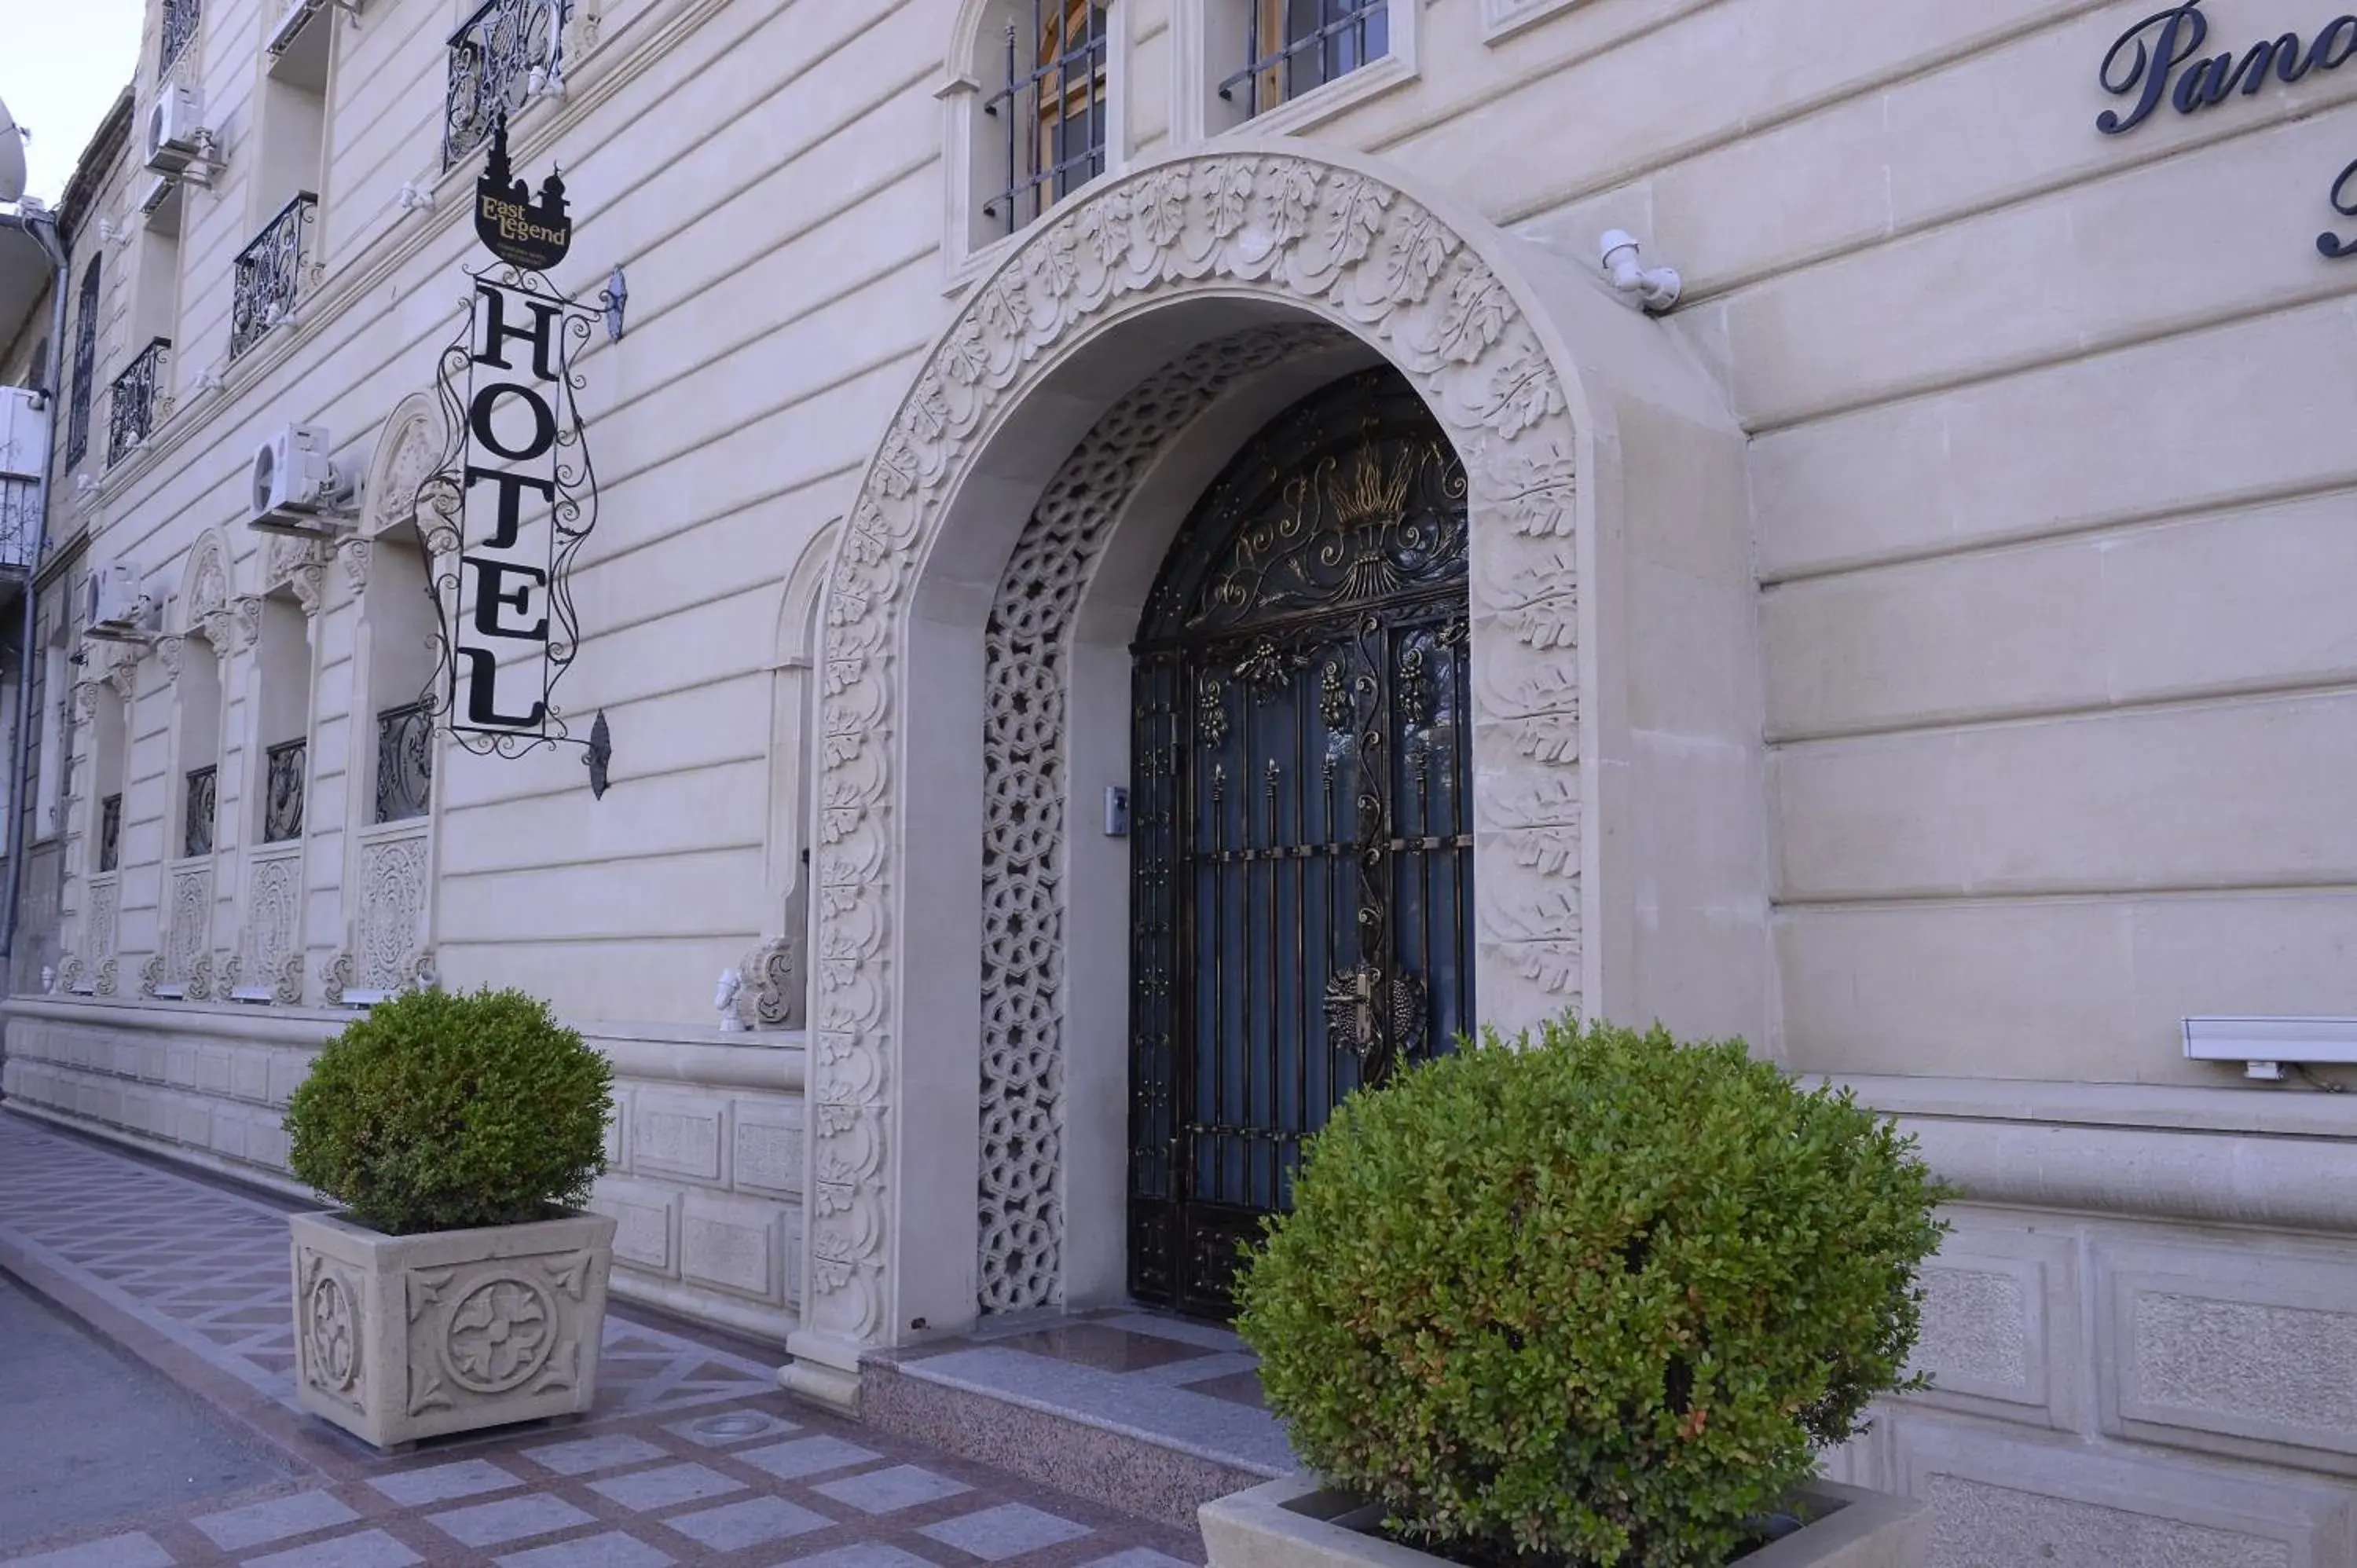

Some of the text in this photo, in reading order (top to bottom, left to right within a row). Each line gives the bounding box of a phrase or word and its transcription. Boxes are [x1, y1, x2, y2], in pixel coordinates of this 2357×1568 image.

[481, 195, 526, 221] East
[499, 216, 566, 246] Legend
[456, 284, 563, 728] HOTEL
